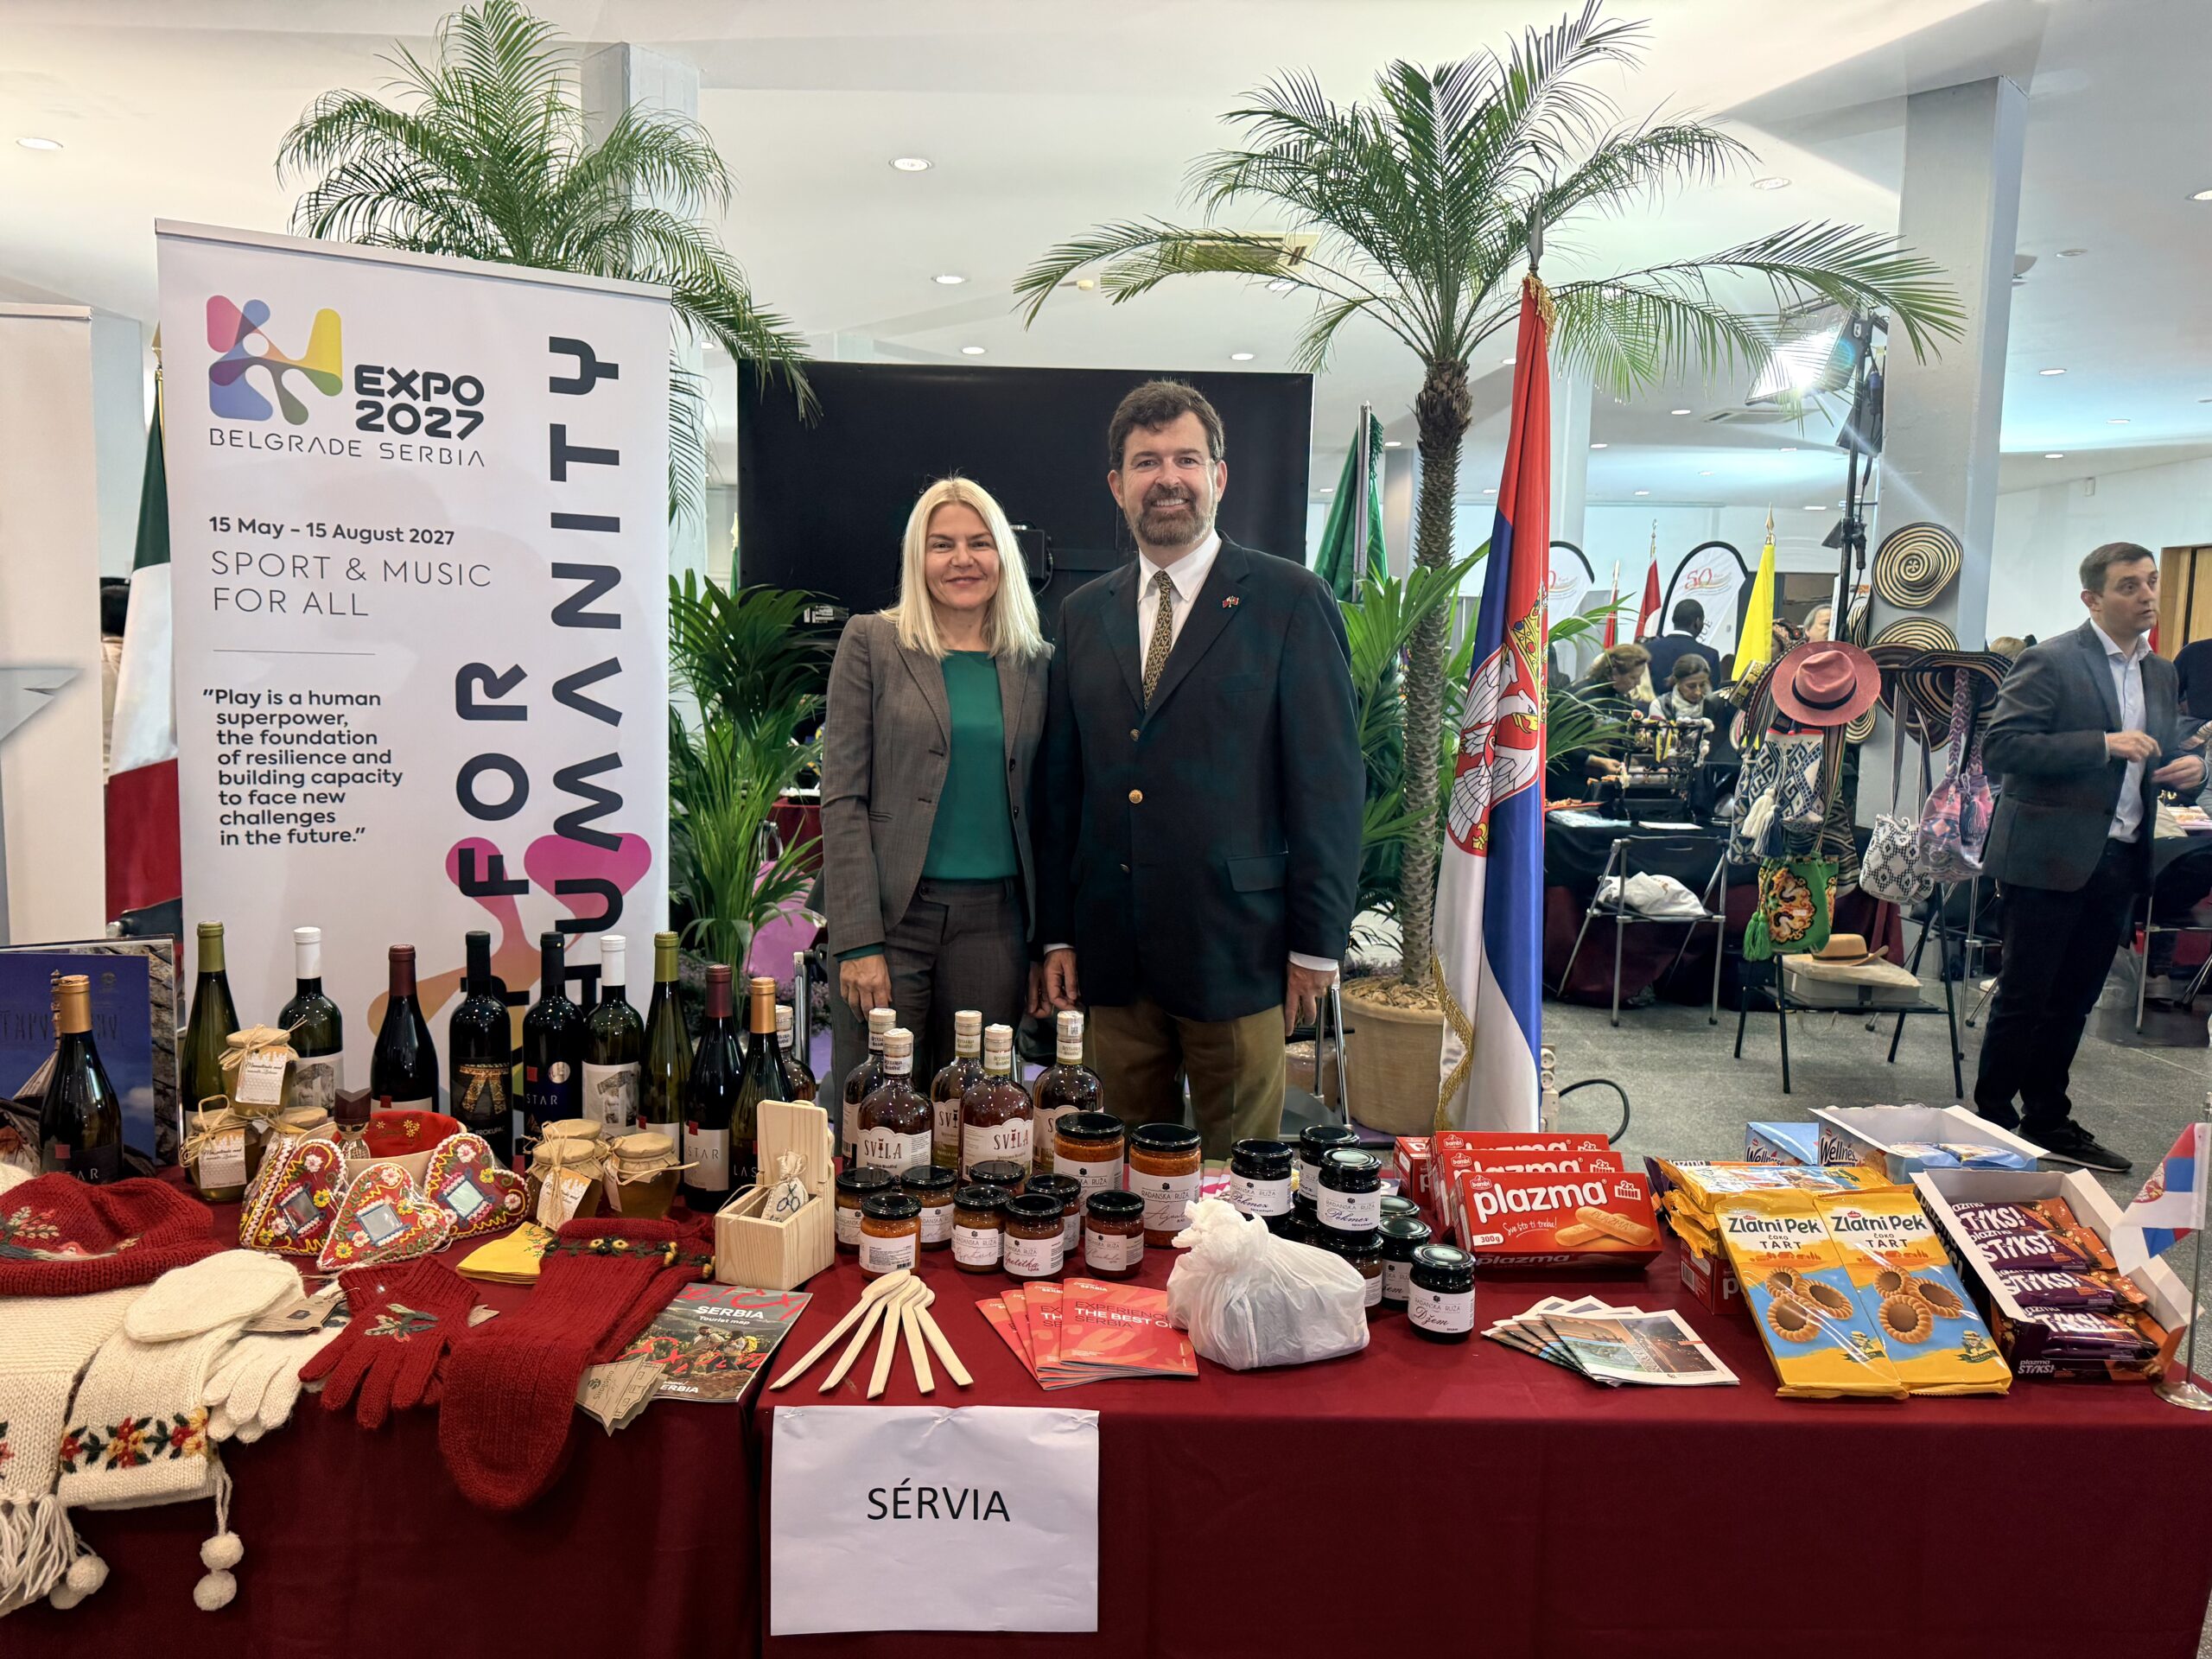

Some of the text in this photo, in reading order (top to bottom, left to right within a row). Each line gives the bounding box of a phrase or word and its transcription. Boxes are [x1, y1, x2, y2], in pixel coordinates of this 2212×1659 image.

[354, 364, 485, 407] EXPO
[355, 399, 485, 441] 2027
[210, 428, 486, 467] BELGRADE SERBIA
[209, 517, 231, 533] 15
[238, 518, 284, 540] May
[306, 523, 327, 538] 15
[332, 524, 404, 547] August
[410, 528, 455, 546] 2027
[211, 550, 492, 588] SPORT & MUSIC
[213, 588, 369, 617] FOR ALL
[267, 690, 283, 706] is
[289, 694, 302, 706] a
[308, 690, 381, 706] human
[217, 709, 348, 728] superpower,
[216, 729, 378, 746] the foundation
[218, 749, 391, 766] of resilience and
[219, 768, 404, 789] building capacity
[455, 661, 530, 897] FOR
[219, 789, 346, 805] to face new
[219, 809, 336, 828] challenges
[219, 830, 240, 846] in
[245, 829, 283, 845] the
[938, 1109, 958, 1128] SVI
[994, 1128, 1028, 1150] SVILA
[1584, 1141, 1596, 1150] 2x
[687, 1146, 719, 1160] STAR
[864, 1138, 902, 1160] SVILA
[1596, 1159, 1609, 1168] 2x
[1471, 1180, 1491, 1189] bambi
[1620, 1180, 1634, 1190] 2x
[1473, 1179, 1608, 1224] plazma
[1729, 1217, 1822, 1233] Zlatni Pek
[1831, 1214, 1929, 1232] Zlatni Pek
[1480, 1235, 1501, 1244] 300g
[1760, 1241, 1802, 1249] TART
[1866, 1239, 1908, 1249] TART
[696, 1306, 766, 1319] SERBIA
[699, 1316, 729, 1325] Tourist
[1074, 1307, 1108, 1319] THE
[1110, 1312, 1152, 1325] BEST
[1074, 1315, 1134, 1329] SERBIA
[660, 1383, 699, 1394] ERBIA
[867, 1478, 1012, 1523] SÉRVIA
